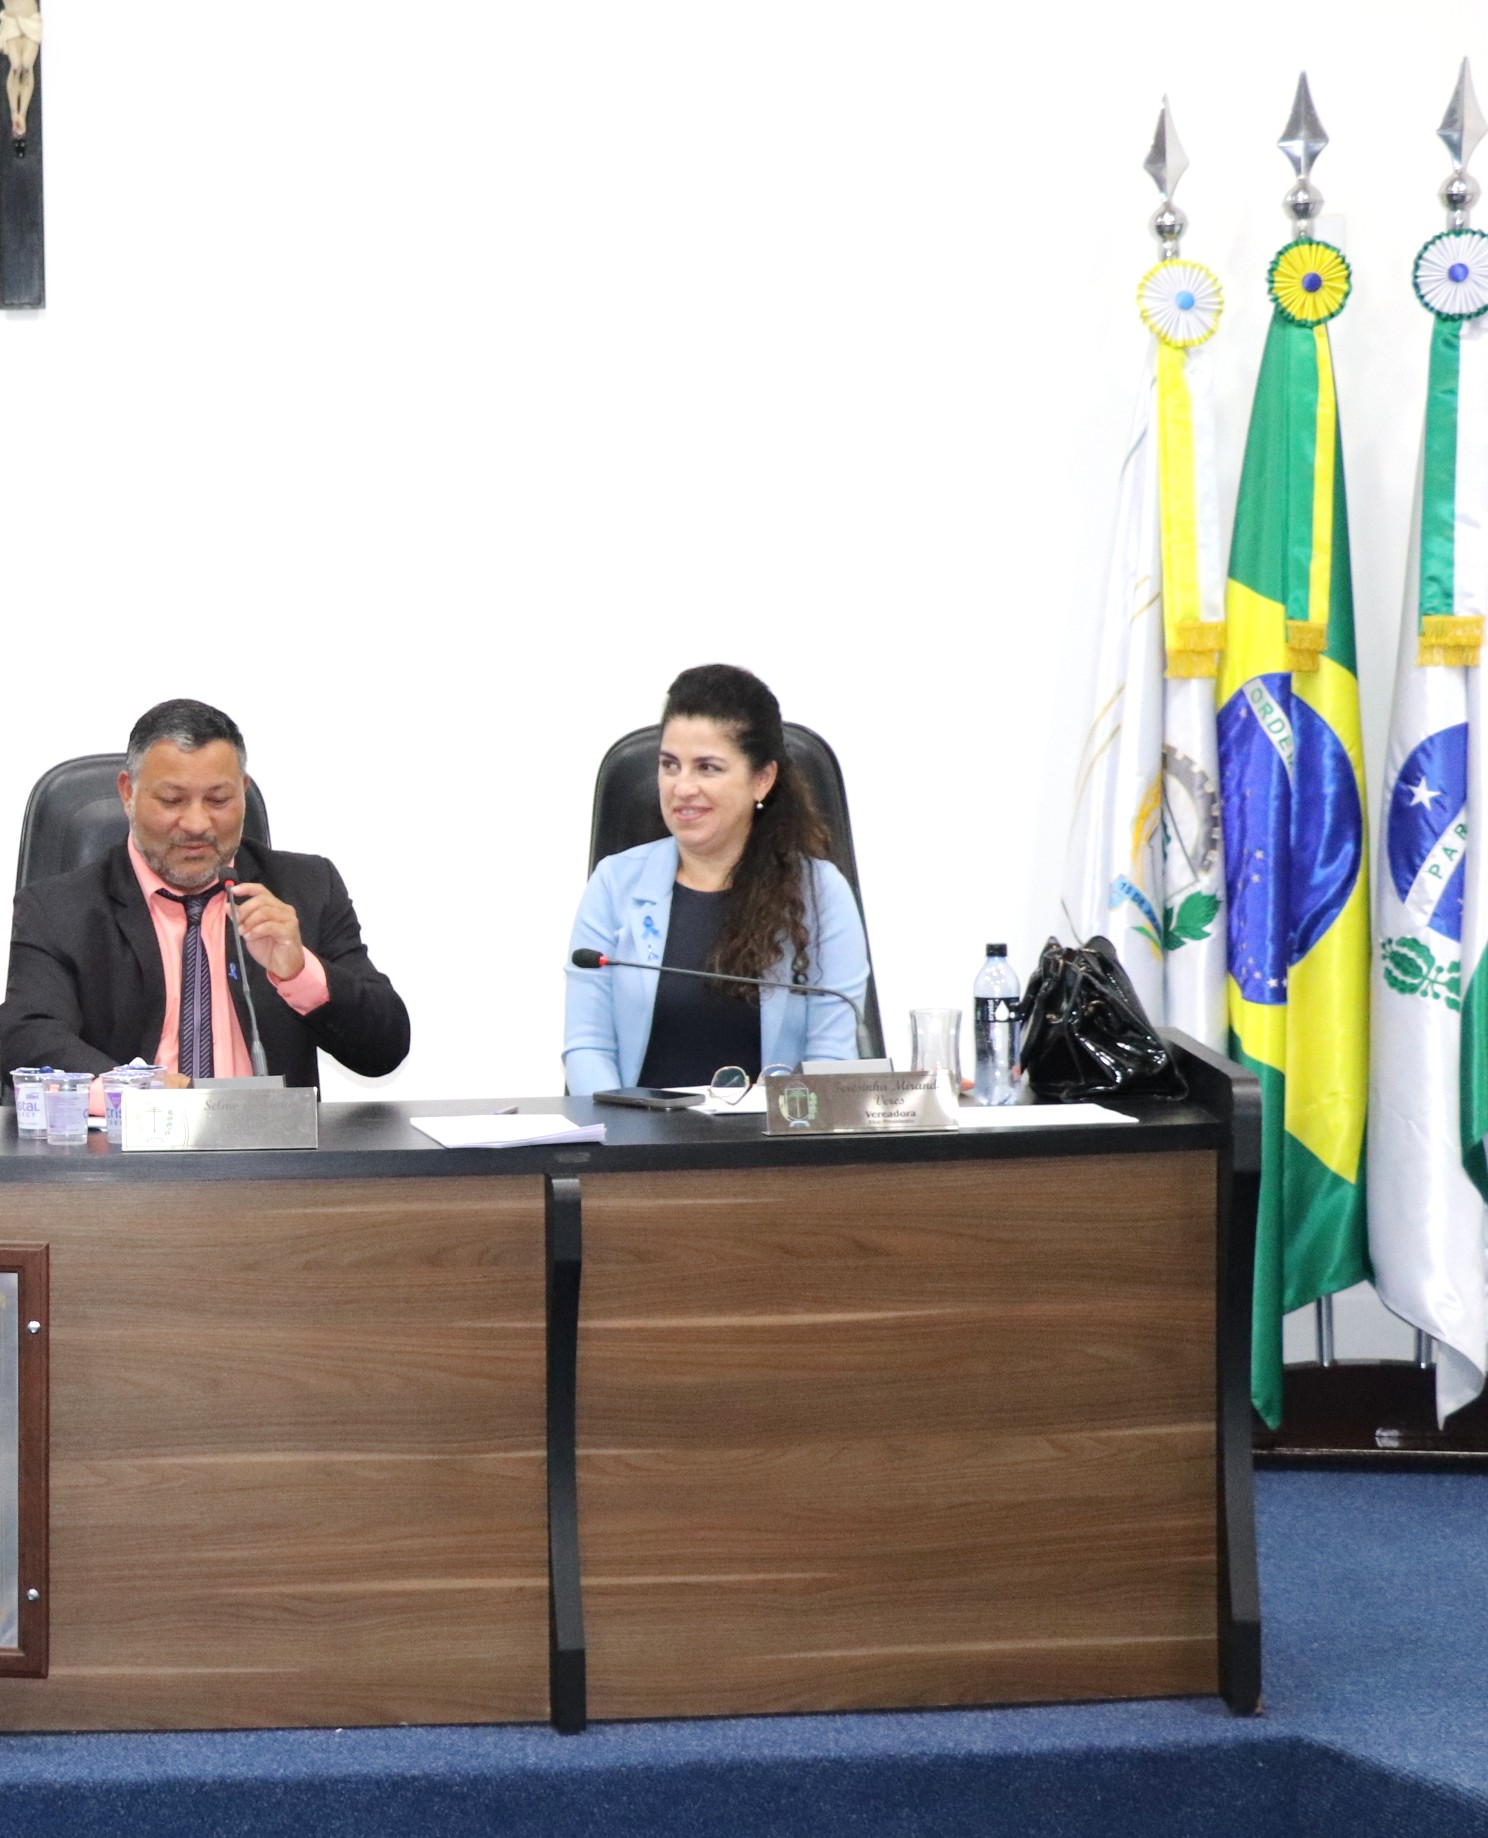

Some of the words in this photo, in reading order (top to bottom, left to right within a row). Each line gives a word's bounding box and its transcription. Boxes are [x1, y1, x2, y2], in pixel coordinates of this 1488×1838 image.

[1427, 824, 1468, 879] PAR
[892, 1079, 939, 1091] Mirand
[865, 1109, 917, 1118] Vereadora
